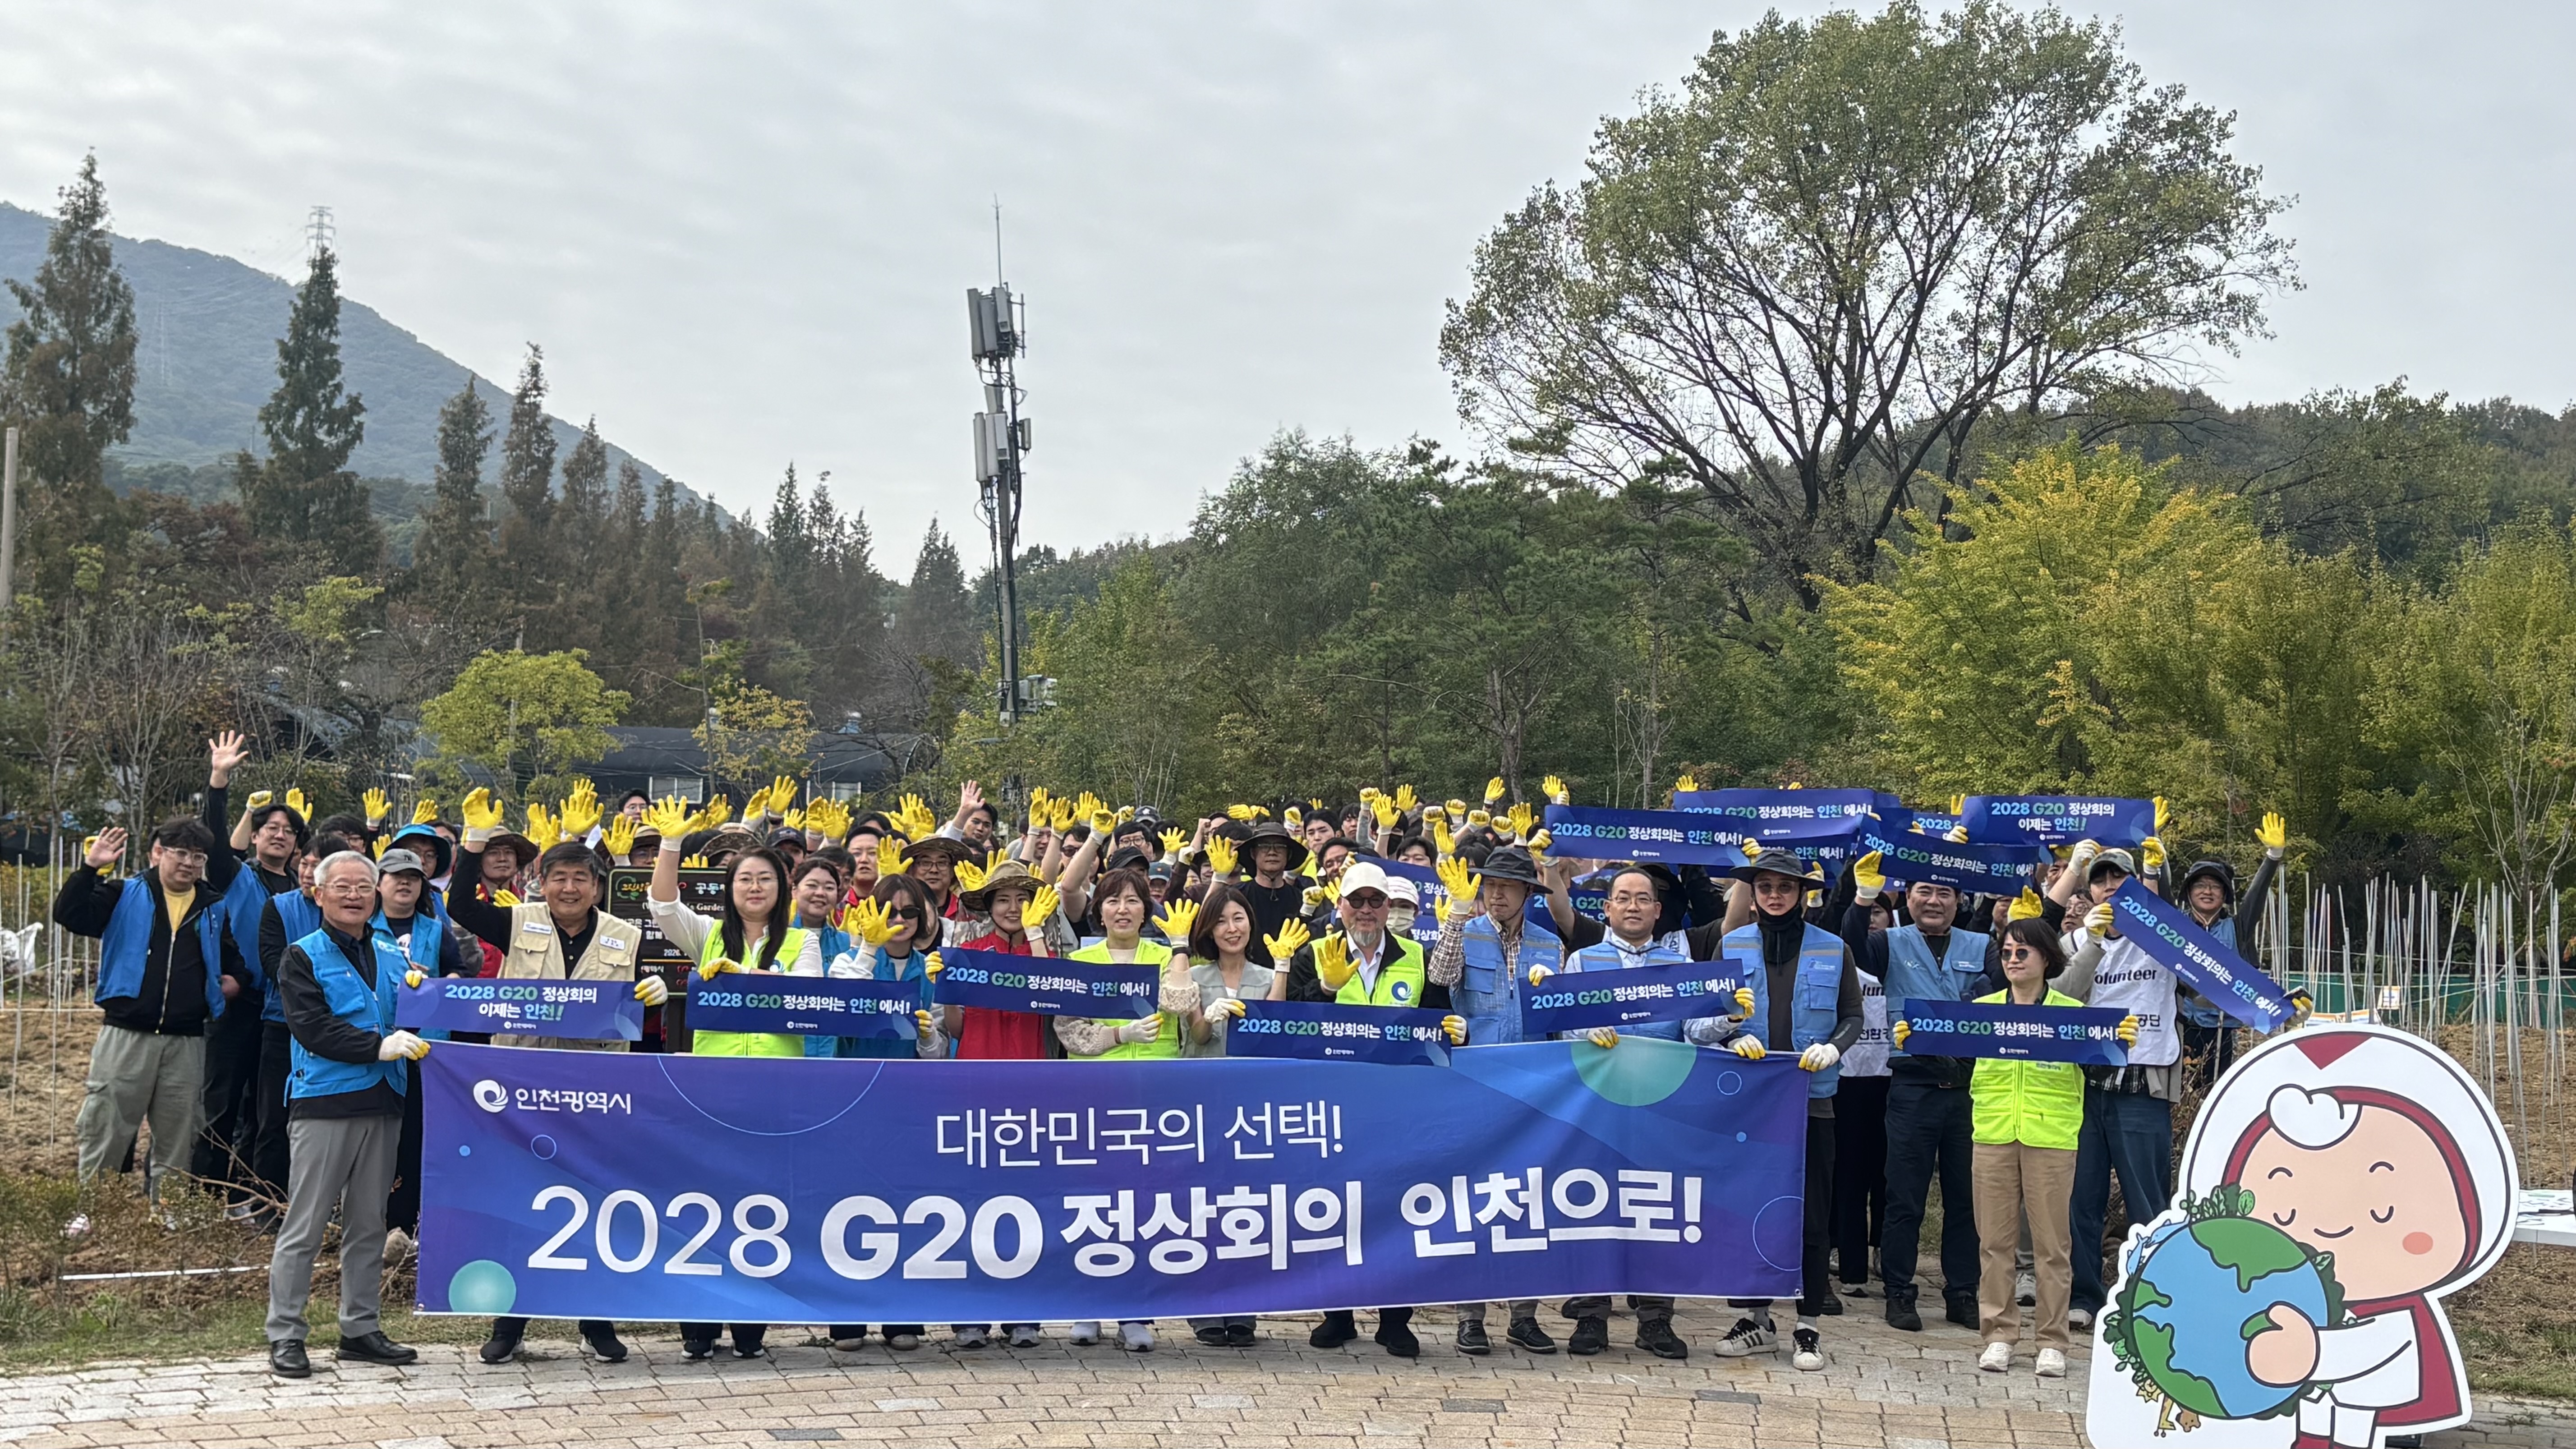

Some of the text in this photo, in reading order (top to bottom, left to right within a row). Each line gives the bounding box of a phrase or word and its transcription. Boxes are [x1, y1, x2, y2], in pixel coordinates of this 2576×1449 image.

[1725, 807, 1757, 819] G20
[1758, 806, 1814, 819] 정상회의는
[1817, 805, 1842, 819] 인천
[1992, 802, 2114, 816] 2028 G20 정상회의
[1551, 822, 1743, 846] 2028 G20 정상회의는 인천 에서!
[1918, 818, 1952, 830] 2028
[2019, 817, 2087, 831] 이제는 인천!
[1795, 846, 1843, 860] 인천 에서!
[1897, 847, 1929, 864] G20
[1930, 853, 1987, 873] 정상회의는
[1991, 863, 2014, 877] 인천
[2120, 896, 2157, 927] 2028
[2156, 923, 2186, 948] G20
[2184, 942, 2233, 985] 정상회의는
[2232, 979, 2257, 1003] 인천
[2255, 996, 2282, 1017] 에서!
[947, 967, 1150, 996] 2028 G20 정상회의는 인천 에서!
[2094, 970, 2156, 984] olunteer
[445, 984, 597, 1003] 2028 G20 정상회의
[698, 992, 910, 1014] 2028 G20 정상회의는 인천 에서!
[1531, 978, 1736, 1010] 2028 G20 정상회의는 인천 에서!
[479, 1003, 564, 1021] 이제는 인천!
[1237, 1018, 1442, 1042] 2028 G20 정상회의는 인천 에서!
[1912, 1017, 1954, 1033] 2028
[1957, 1021, 1992, 1035] G20
[1993, 1021, 2054, 1038] 정상회의는
[2059, 1025, 2085, 1040] 인천
[515, 1089, 631, 1114] 인천광역시
[937, 1100, 1343, 1168] 대한민국의 선택!
[528, 1167, 1702, 1280] 2028 G20 정상회의 인천으로!
